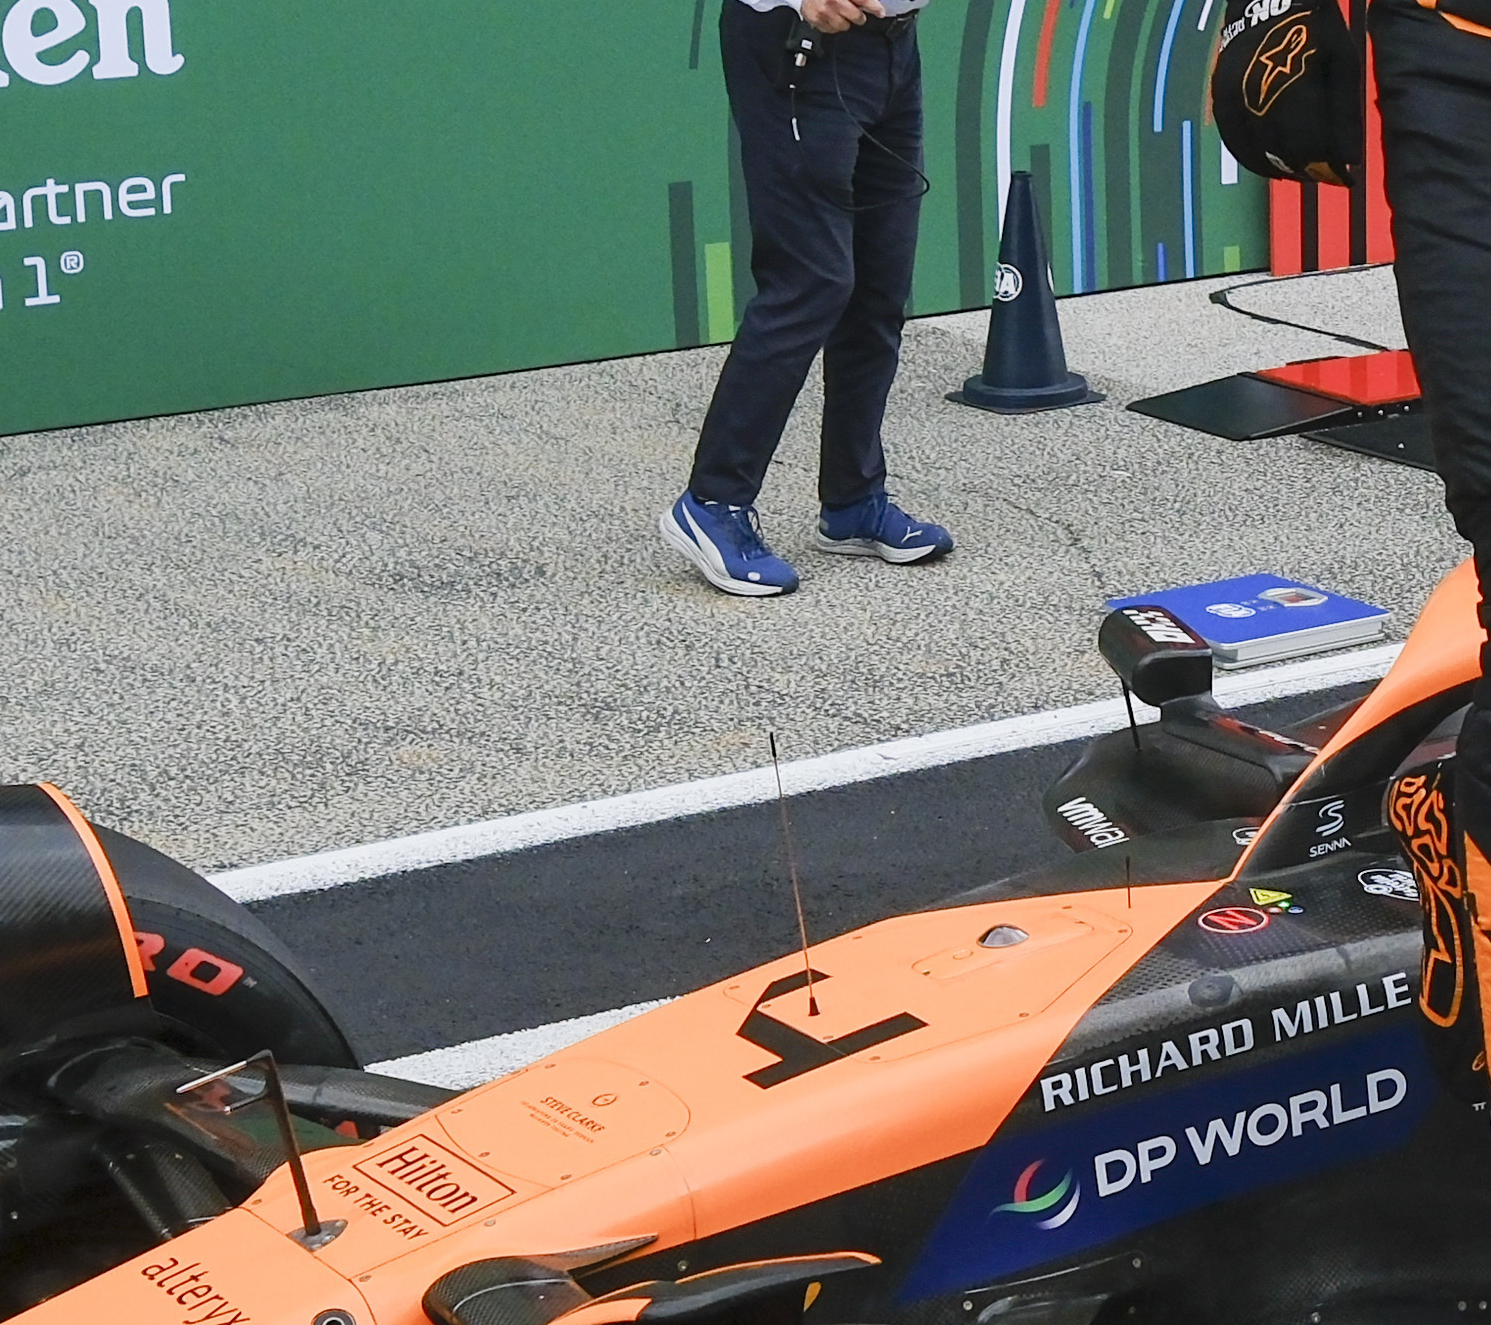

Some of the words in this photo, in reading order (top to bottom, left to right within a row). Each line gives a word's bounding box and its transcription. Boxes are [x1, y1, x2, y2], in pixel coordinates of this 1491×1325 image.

[1308, 836, 1353, 859] SENNA
[1040, 1011, 1256, 1113] RICHARD
[1272, 970, 1414, 1043] MILLE
[1093, 1134, 1179, 1198] DP
[1186, 1067, 1408, 1168] WORLD
[322, 1173, 360, 1198] FOR
[353, 1192, 392, 1217] THE
[382, 1212, 430, 1241] STAY
[375, 1145, 479, 1215] Hilton
